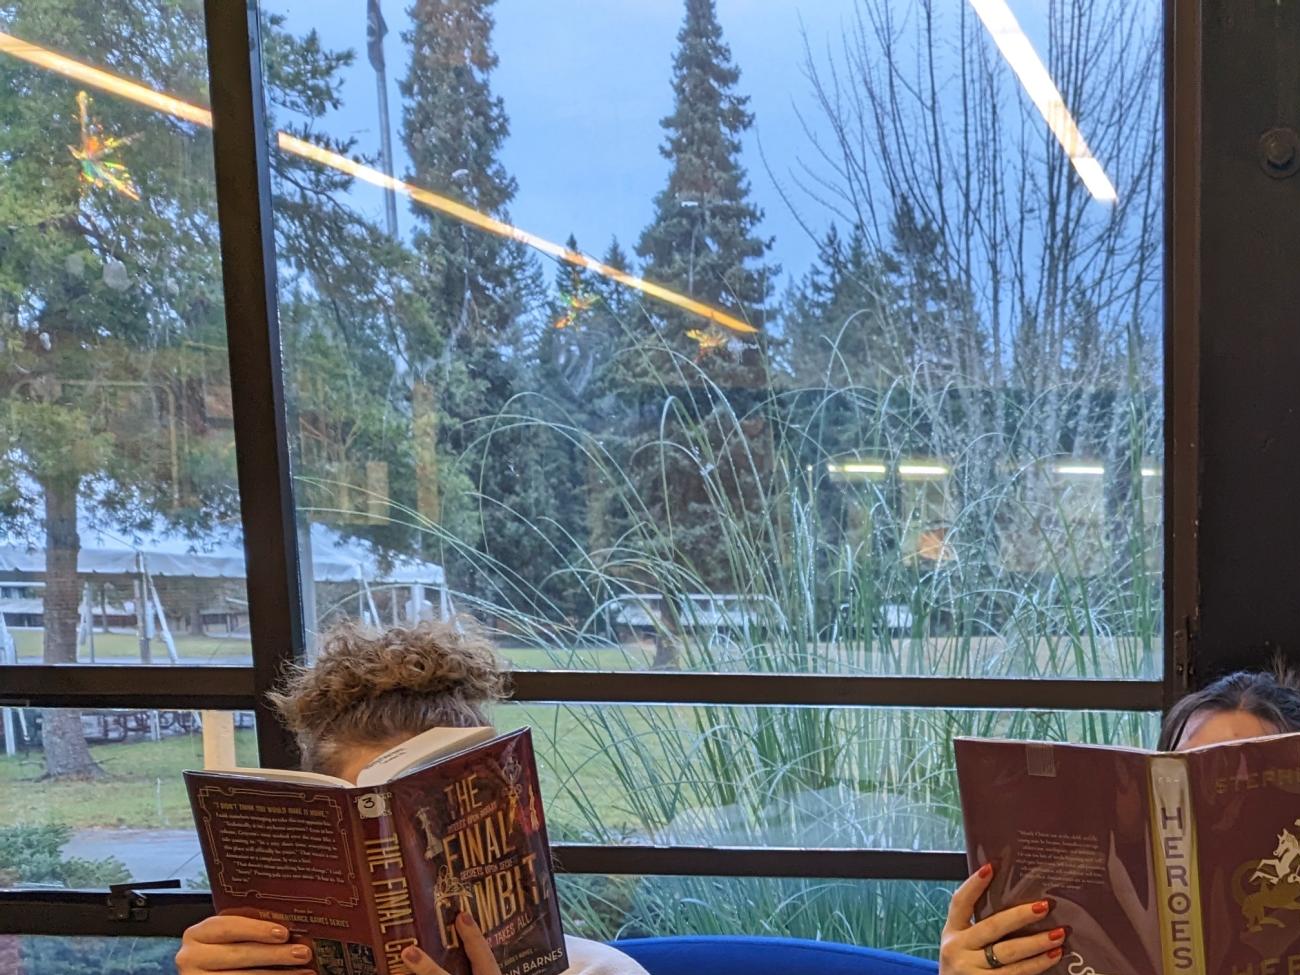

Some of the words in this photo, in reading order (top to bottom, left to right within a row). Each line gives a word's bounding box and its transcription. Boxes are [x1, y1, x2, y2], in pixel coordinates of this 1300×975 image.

[362, 796, 375, 809] 3
[443, 773, 482, 820] THE
[365, 833, 403, 873] THE
[442, 810, 516, 877] FINAL
[372, 877, 414, 934] FINAL
[1161, 806, 1194, 970] HEROES
[494, 922, 516, 944] TAKES
[523, 947, 564, 973] BARNES
